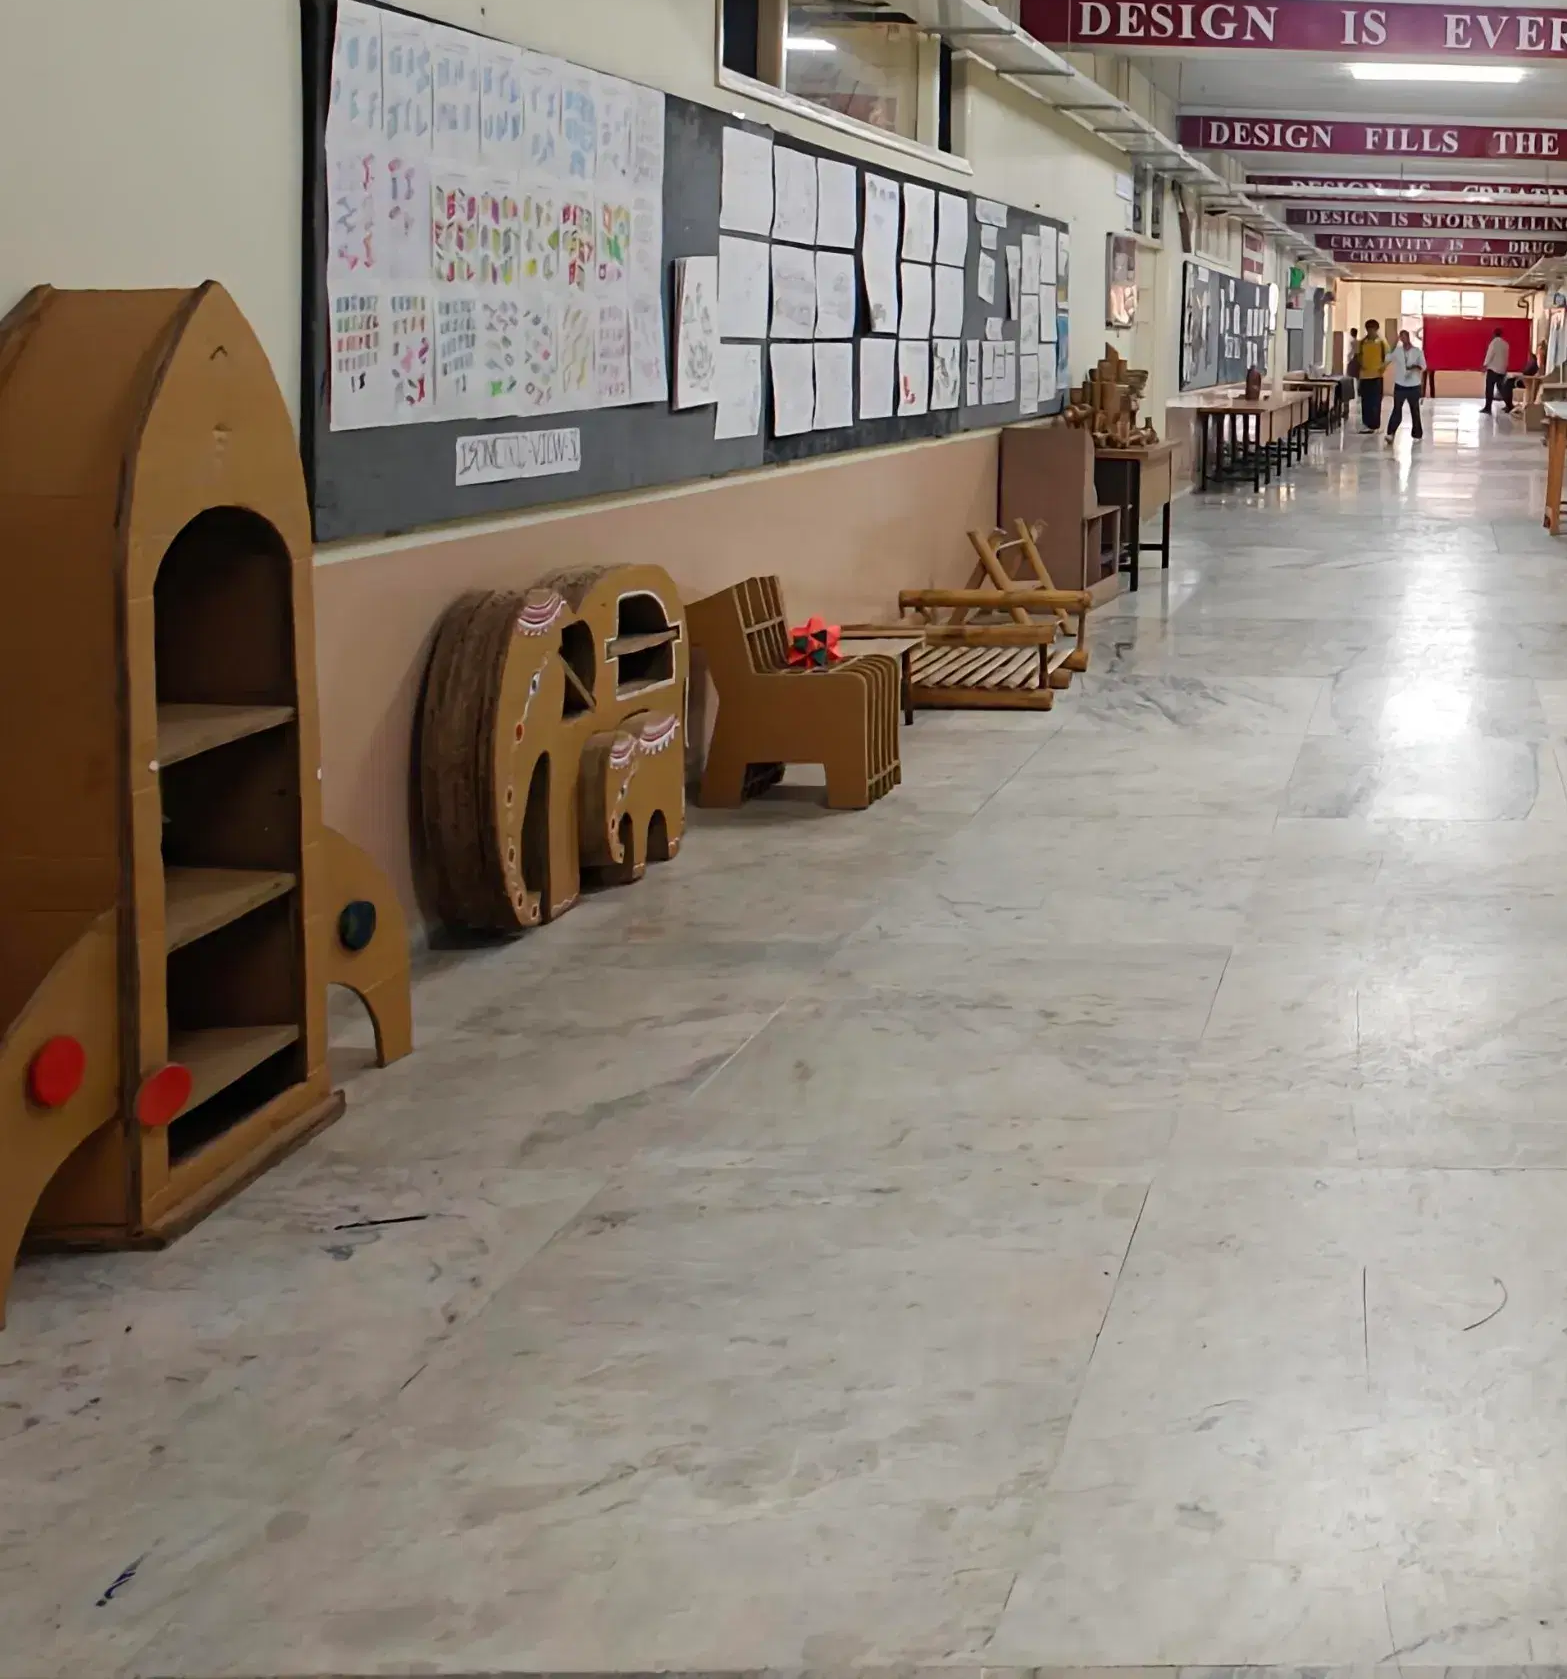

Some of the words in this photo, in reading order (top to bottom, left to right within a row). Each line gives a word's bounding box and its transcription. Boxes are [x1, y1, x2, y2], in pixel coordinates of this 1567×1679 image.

[1077, 1, 1279, 43] DESIGN
[1340, 9, 1387, 46] IS
[1208, 121, 1333, 149] DESIGN
[1365, 127, 1459, 153] FILLS
[1493, 131, 1559, 155] THE
[1306, 209, 1380, 226] DESIGN
[1391, 212, 1409, 227] IS
[1330, 235, 1434, 251] CREATIVITY
[1449, 239, 1464, 252] IS
[1480, 241, 1491, 253] A
[1508, 241, 1555, 254] DRUG
[1350, 251, 1418, 264] CREATED
[1440, 254, 1458, 265] TO
